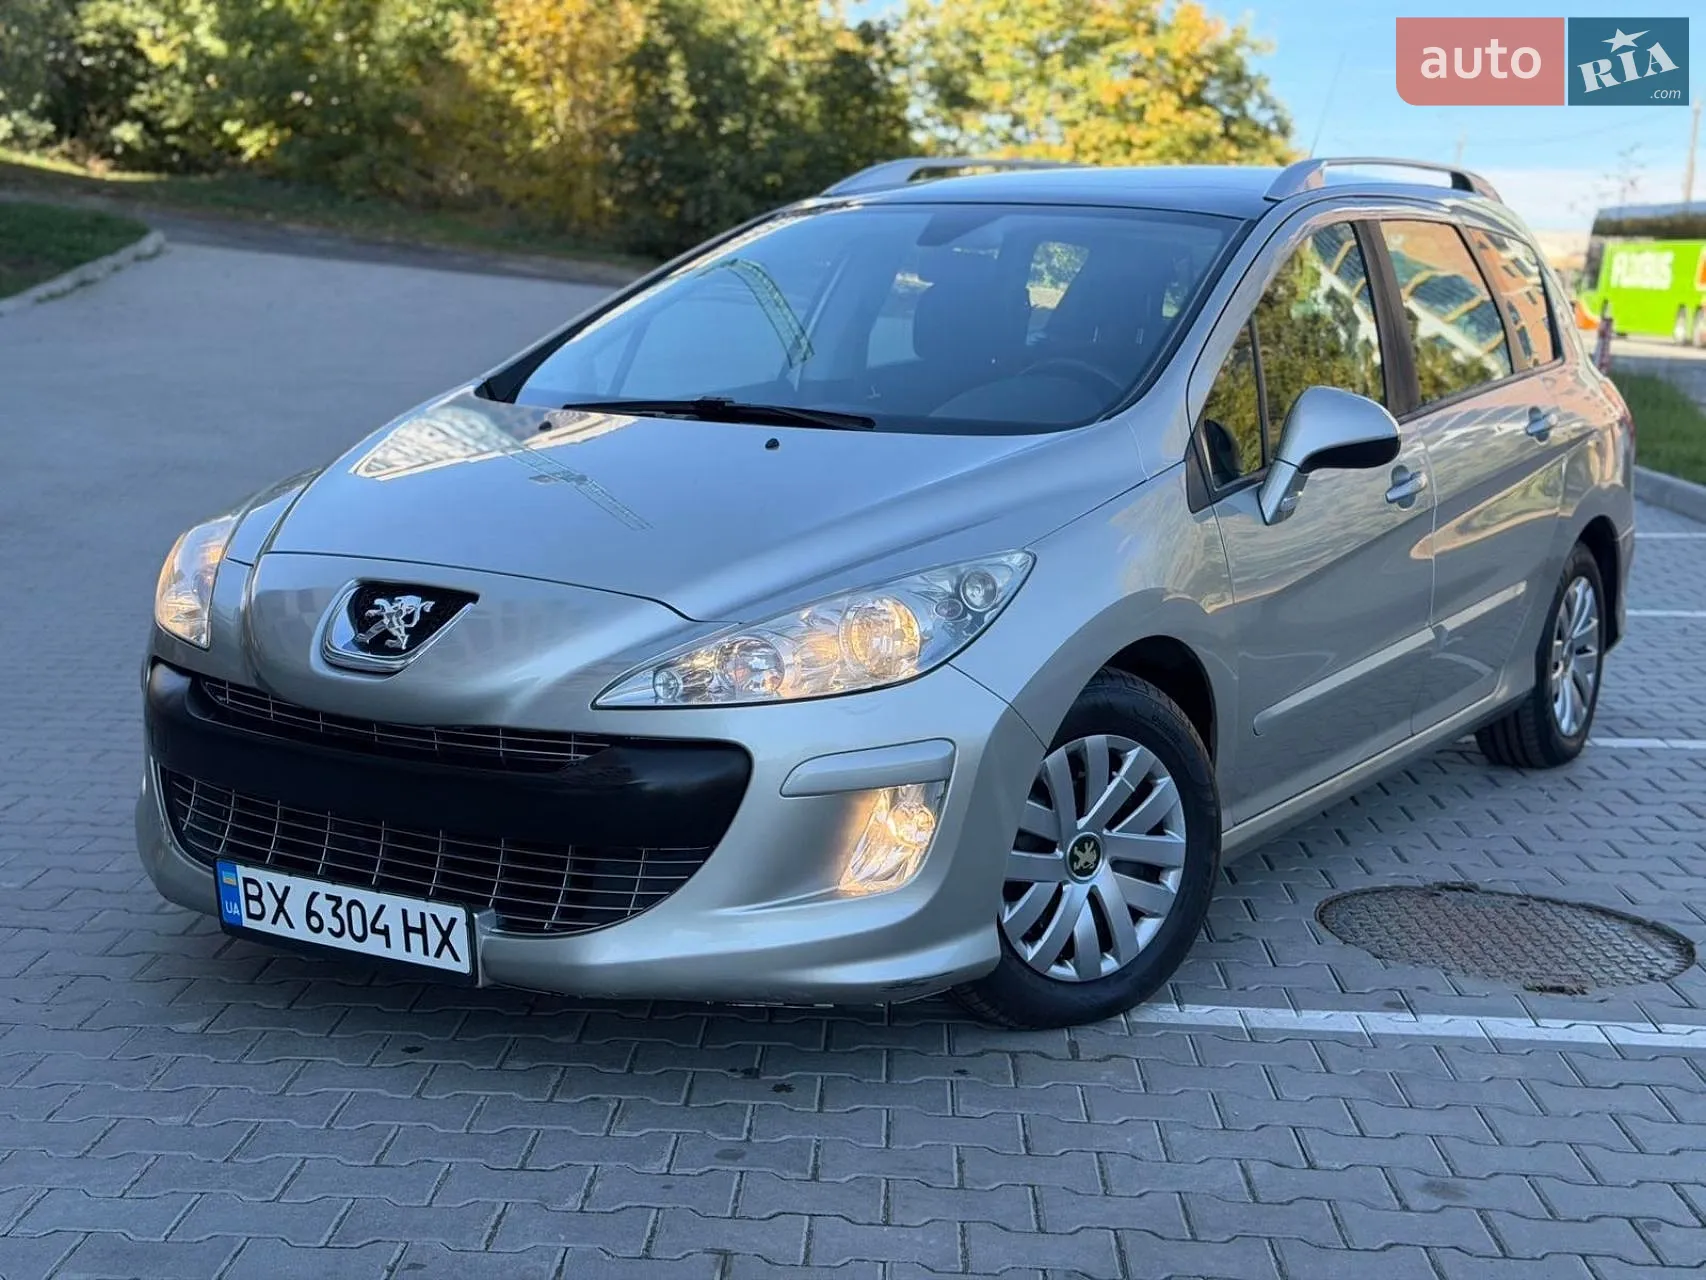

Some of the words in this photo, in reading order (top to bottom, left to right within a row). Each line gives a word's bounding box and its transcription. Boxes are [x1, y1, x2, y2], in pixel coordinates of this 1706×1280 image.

[225, 900, 241, 916] UA
[242, 876, 295, 930] BX
[305, 891, 391, 949] 6304
[401, 908, 461, 963] HX
